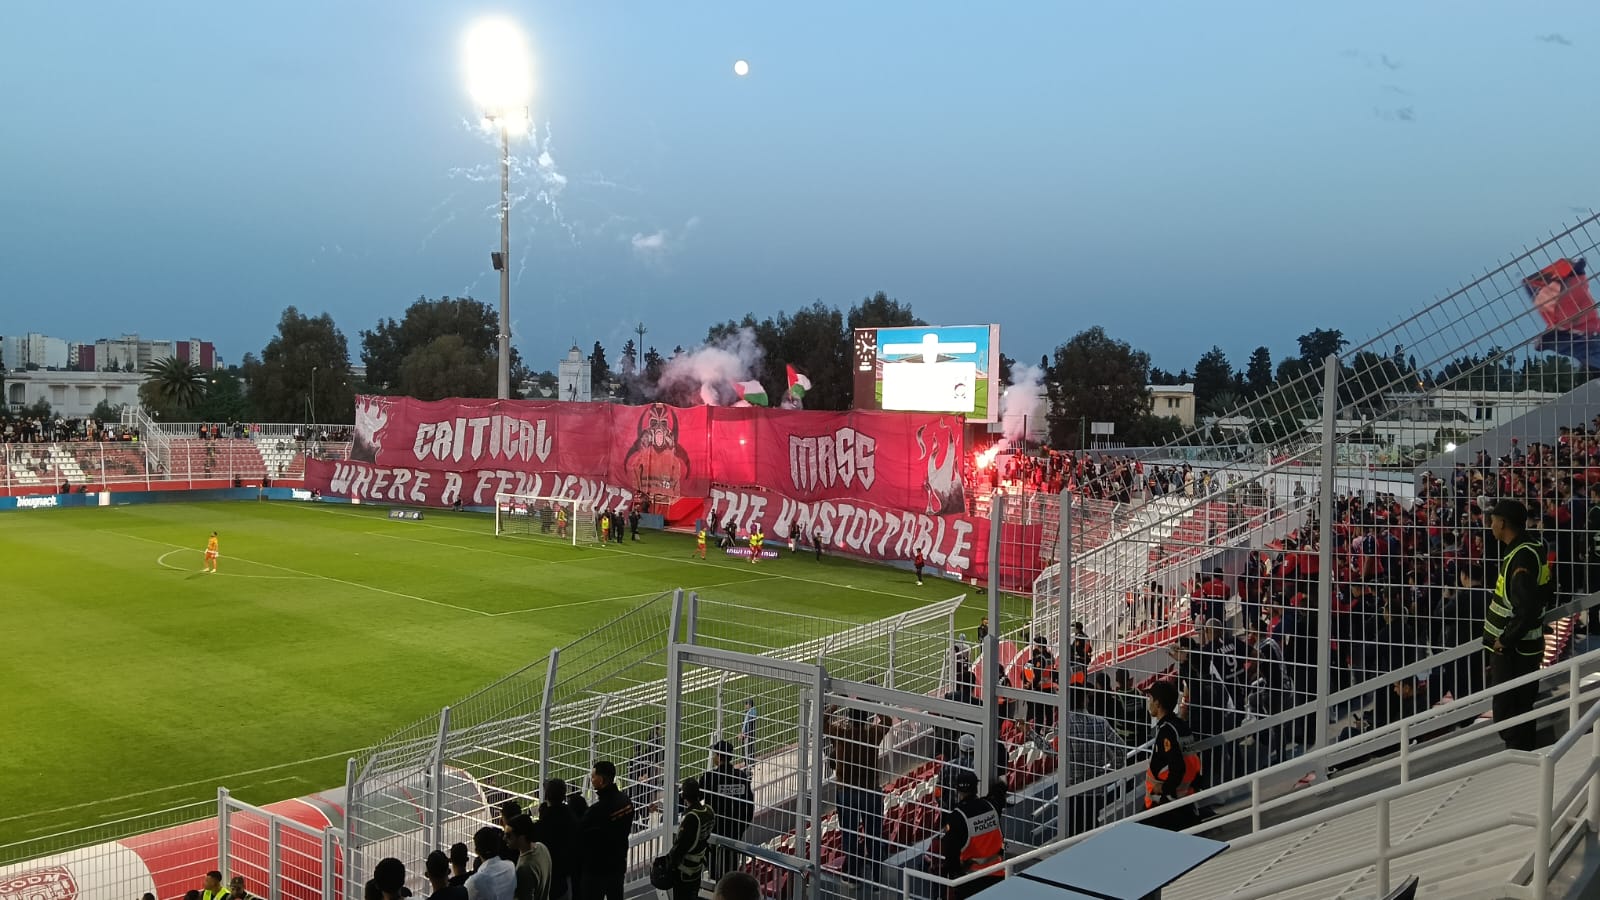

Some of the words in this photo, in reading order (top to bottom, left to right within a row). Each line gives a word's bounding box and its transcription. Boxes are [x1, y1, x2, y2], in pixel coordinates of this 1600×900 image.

[413, 415, 551, 463] CRITICAL
[789, 427, 876, 491] MASS
[330, 462, 431, 502] WHERE
[442, 472, 463, 504] A
[474, 470, 543, 505] FEW
[551, 473, 634, 515] IGNITE
[706, 488, 768, 532] THE
[773, 499, 972, 569] UNSTOPPABLE
[974, 820, 997, 832] POLICE
[0, 873, 60, 893] CODM
